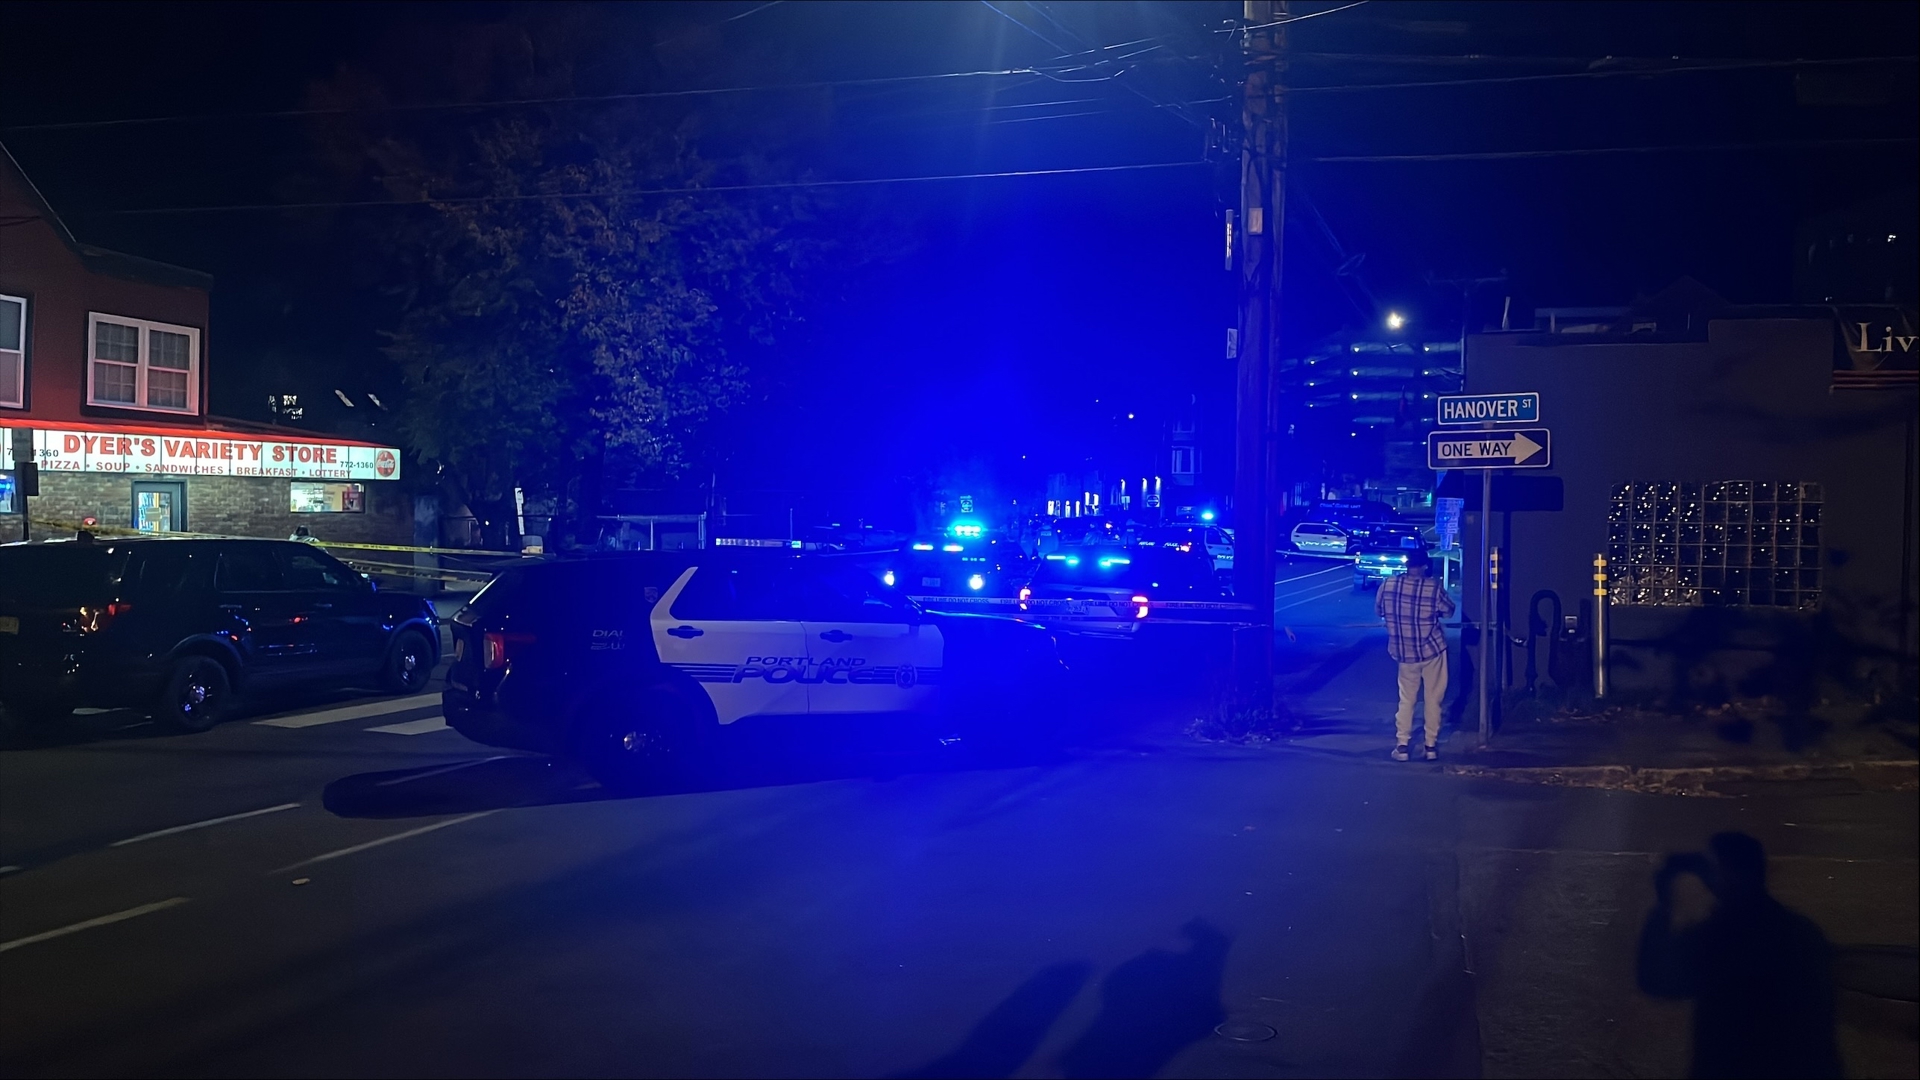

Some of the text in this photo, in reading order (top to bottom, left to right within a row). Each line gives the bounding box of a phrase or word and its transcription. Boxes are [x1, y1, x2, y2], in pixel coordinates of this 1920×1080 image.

[1444, 398, 1532, 419] HANOVER ST
[63, 434, 337, 464] DYER'S VARIETY STORE
[1442, 442, 1512, 457] ONE WAY
[41, 460, 352, 478] PIZZA SOUP SANDWICHES BREAKFAST LOTTERY
[340, 461, 374, 469] 772-1360
[746, 656, 866, 666] PORTLAND
[733, 665, 875, 684] POLICE
